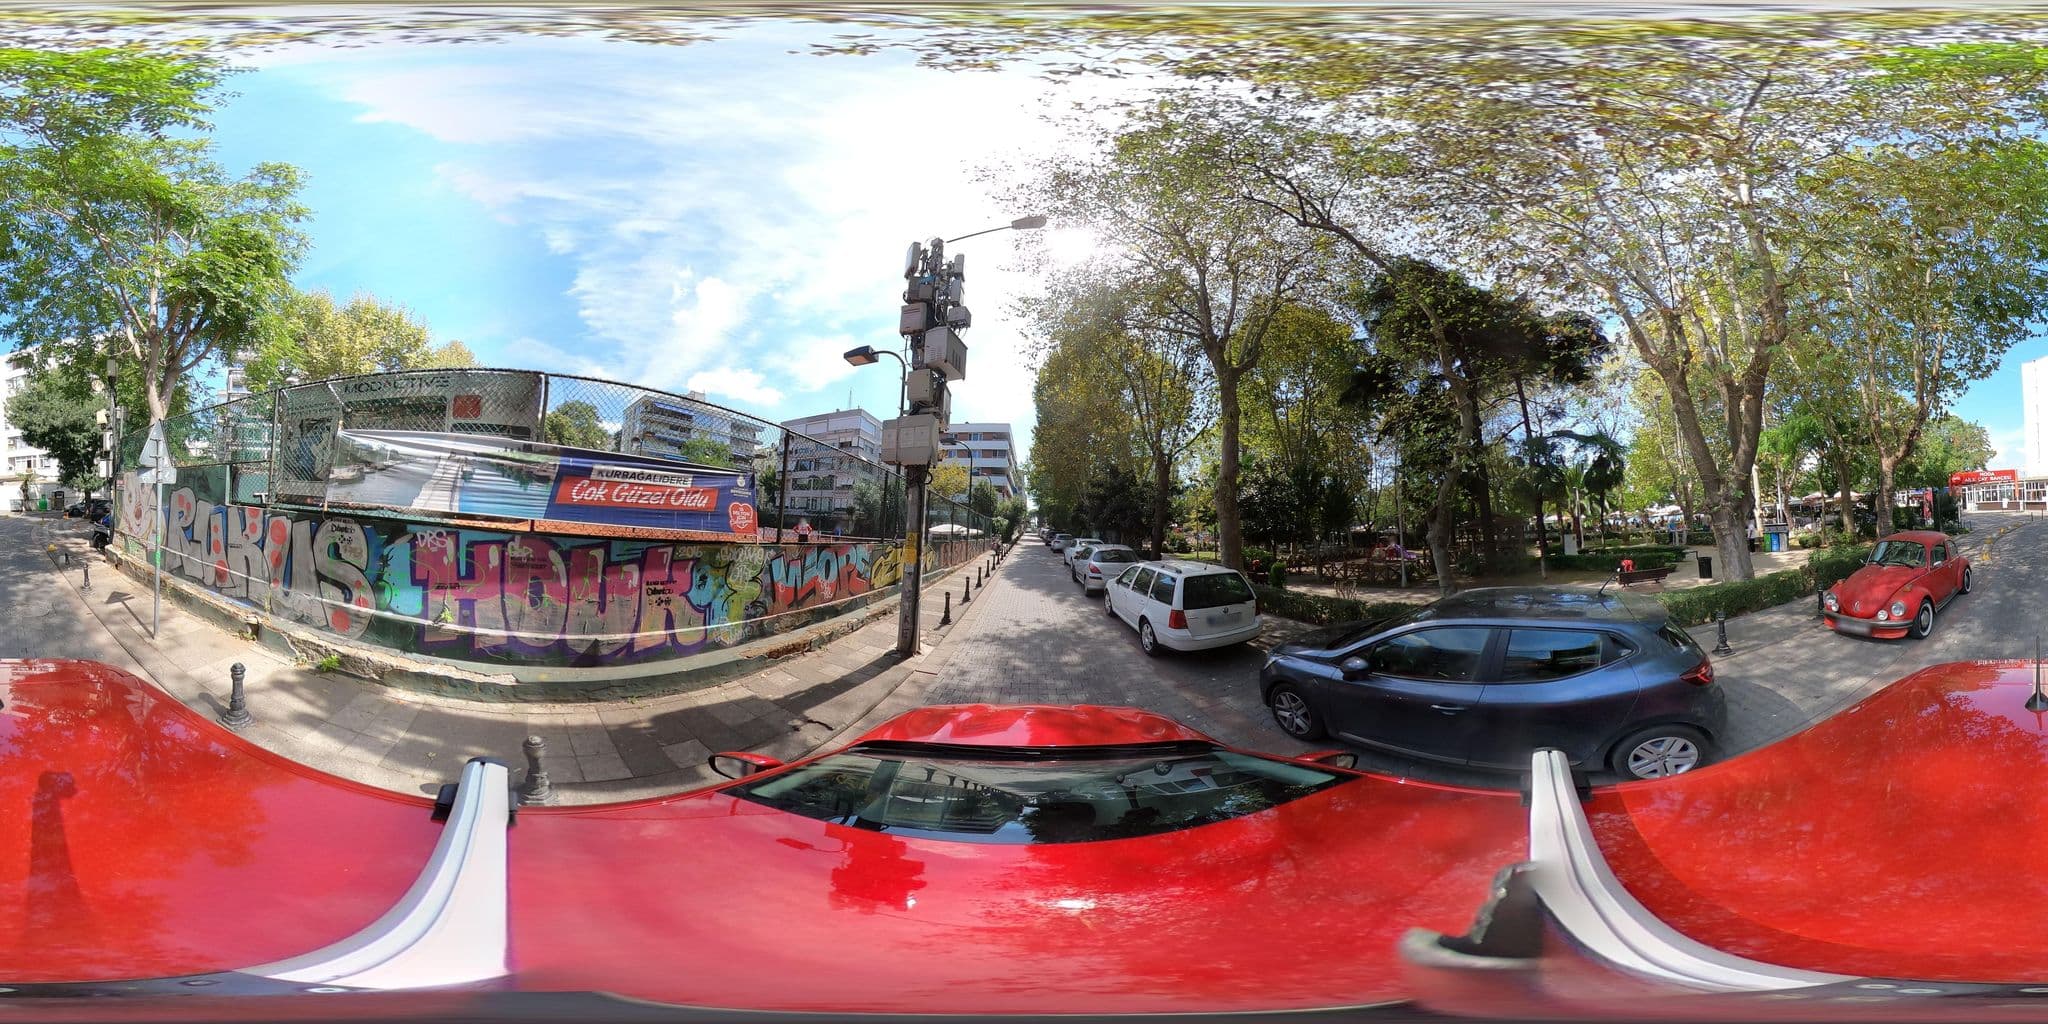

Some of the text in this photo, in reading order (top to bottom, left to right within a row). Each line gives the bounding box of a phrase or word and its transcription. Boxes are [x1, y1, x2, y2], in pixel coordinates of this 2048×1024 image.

[571, 479, 607, 503] Çok
[612, 486, 665, 506] Güzel
[670, 488, 709, 508] Oldu
